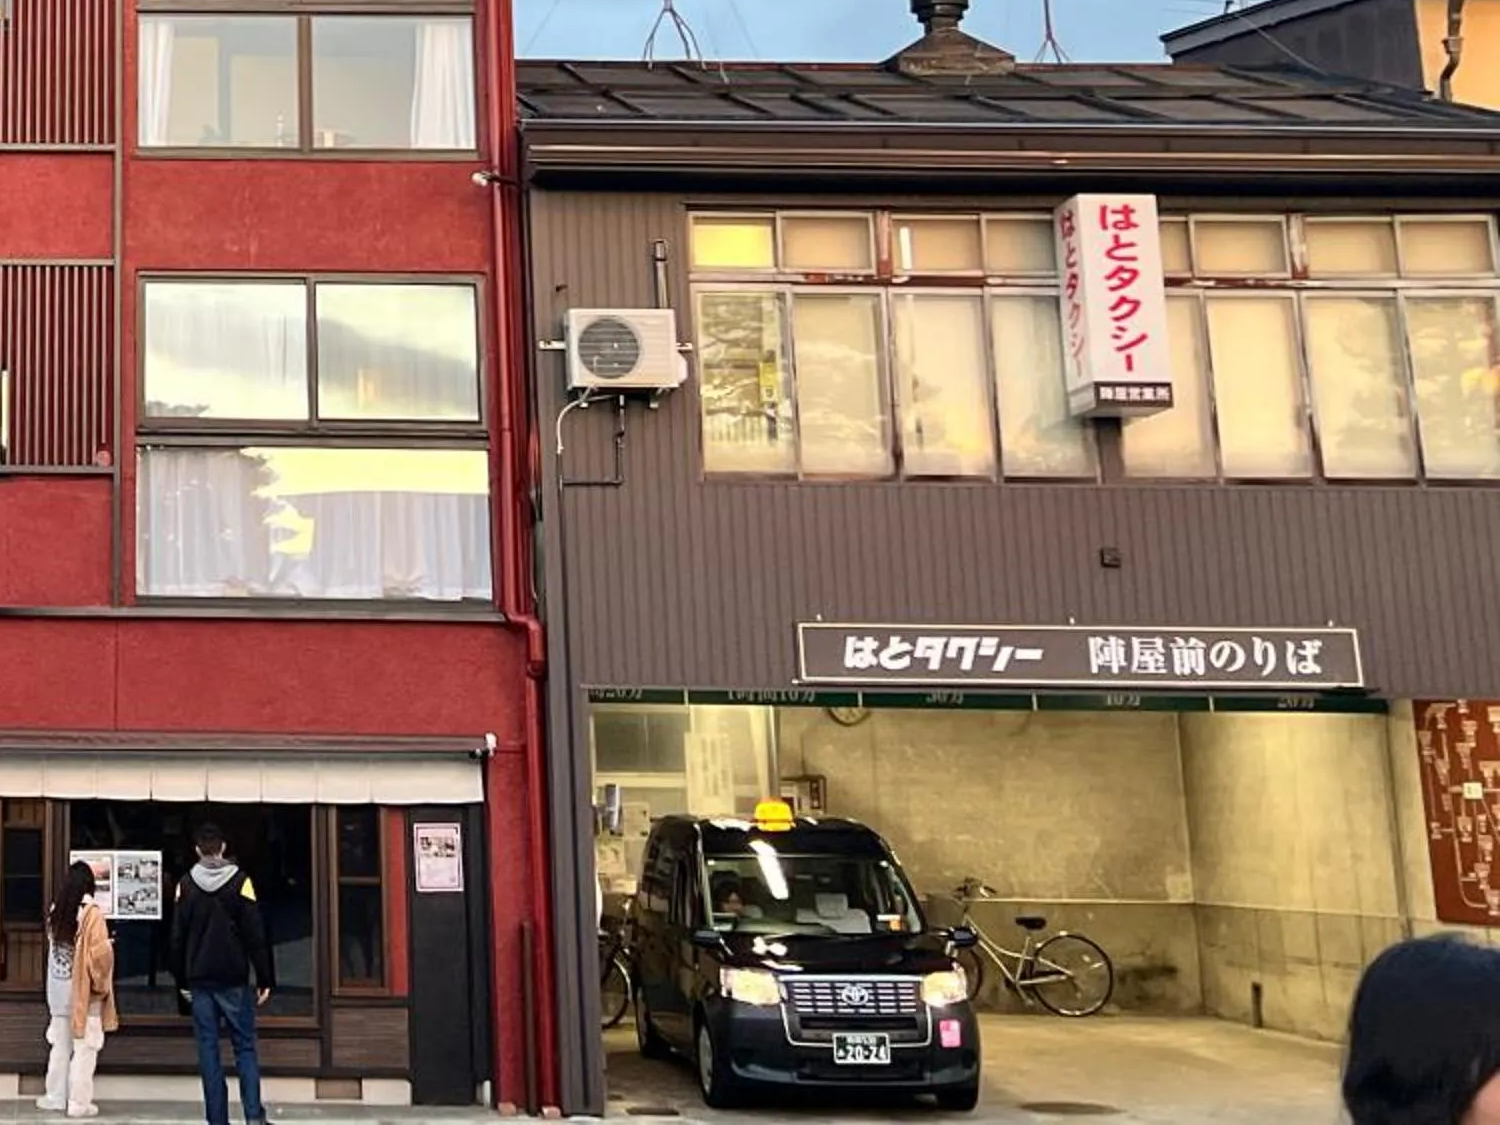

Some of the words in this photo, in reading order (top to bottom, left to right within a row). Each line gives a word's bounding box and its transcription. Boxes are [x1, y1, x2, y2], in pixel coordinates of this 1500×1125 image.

[1060, 209, 1084, 378] はとタクシー
[1098, 204, 1148, 371] はとタクシー
[844, 635, 1044, 671] はとタクシー
[1088, 635, 1322, 675] 陣屋前のりば
